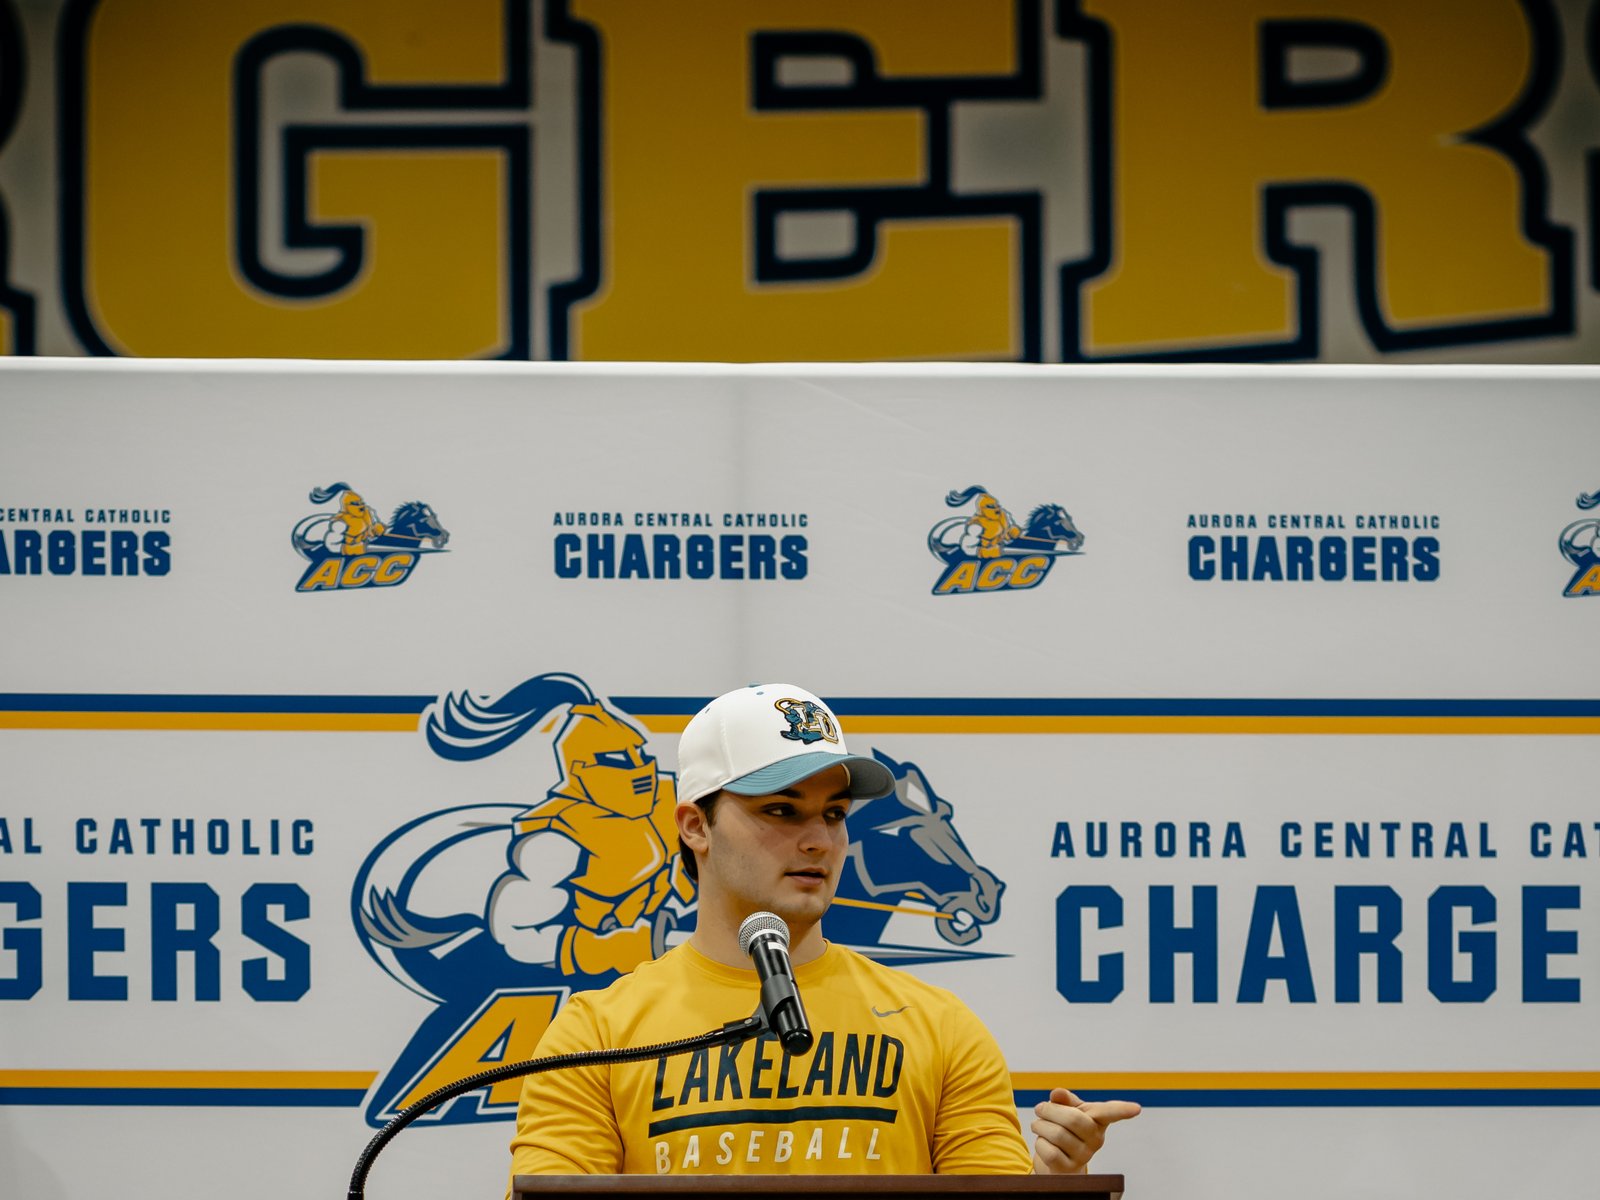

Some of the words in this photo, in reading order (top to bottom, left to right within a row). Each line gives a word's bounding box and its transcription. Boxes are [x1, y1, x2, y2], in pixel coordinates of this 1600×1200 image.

[85, 509, 171, 523] CATHOLIC
[553, 512, 624, 527] AURORA
[635, 513, 712, 527] CENTRAL
[722, 514, 808, 528] CATHOLIC
[1187, 515, 1257, 529] AURORA
[1268, 515, 1346, 529] CENTRAL
[1356, 515, 1440, 529] CATHOLIC
[299, 553, 414, 590] ACC
[554, 533, 808, 581] CHARGERS
[934, 554, 1049, 593] ACC
[1188, 535, 1440, 582] CHARGERS
[76, 818, 314, 855] CATHOLIC
[1050, 822, 1247, 858] AURORA
[1280, 822, 1497, 858] CENTRAL
[1056, 885, 1581, 1003] CHARGE
[652, 1031, 904, 1112] LAKELAND
[655, 1126, 881, 1174] BASEBALL
